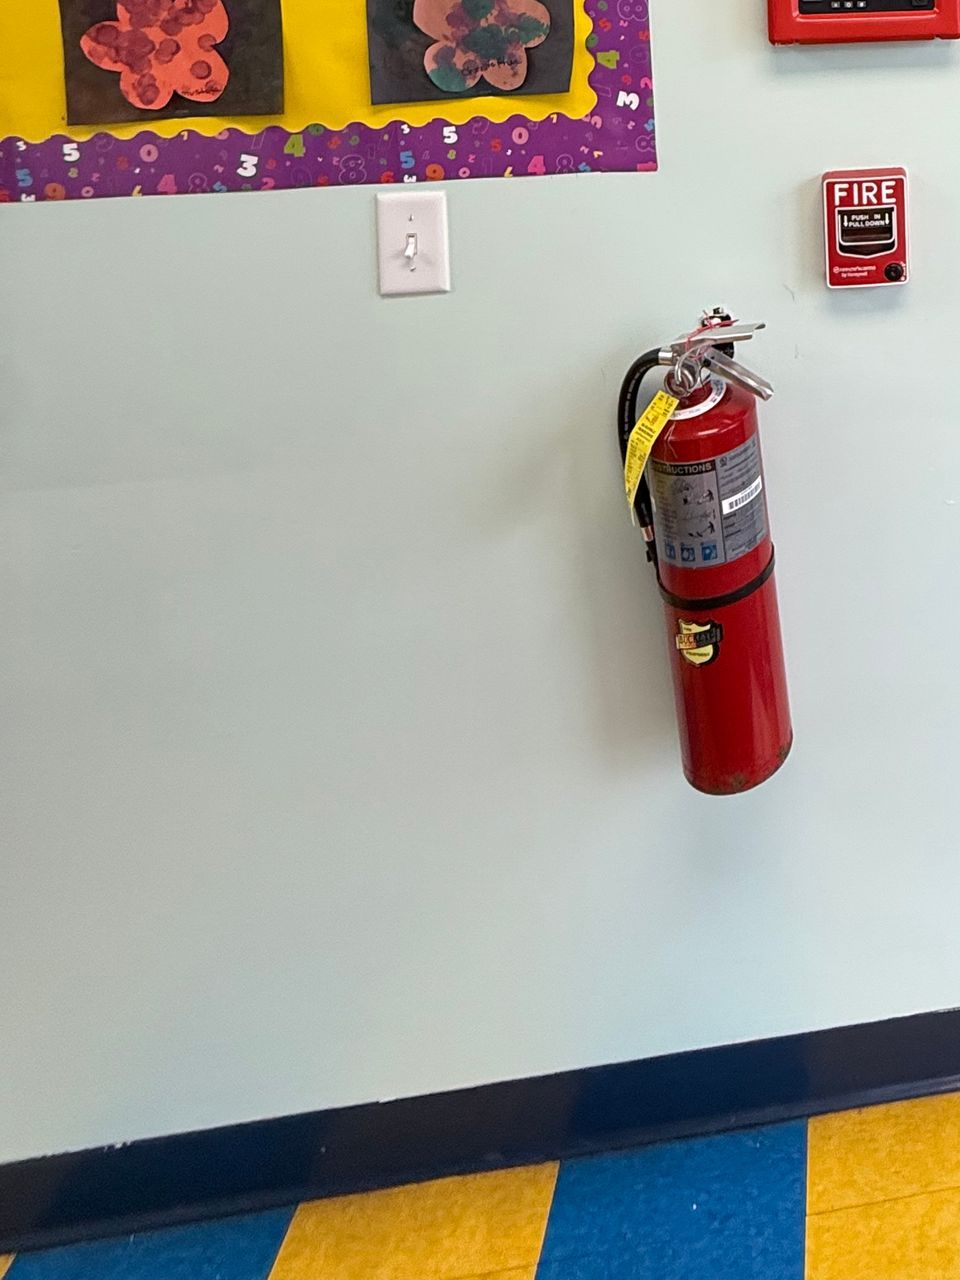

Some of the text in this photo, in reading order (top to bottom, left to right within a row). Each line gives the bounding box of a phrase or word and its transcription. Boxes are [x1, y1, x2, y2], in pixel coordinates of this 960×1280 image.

[616, 90, 640, 111] 3
[443, 126, 458, 144] 5
[62, 143, 80, 162] 5
[284, 134, 306, 157] 4
[236, 154, 258, 177] 3
[400, 151, 415, 169] 5
[528, 156, 546, 175] 4
[16, 169, 33, 187] 5
[157, 174, 178, 194] 4
[834, 181, 896, 206] FIRE
[653, 462, 712, 475] STRUCTIONS
